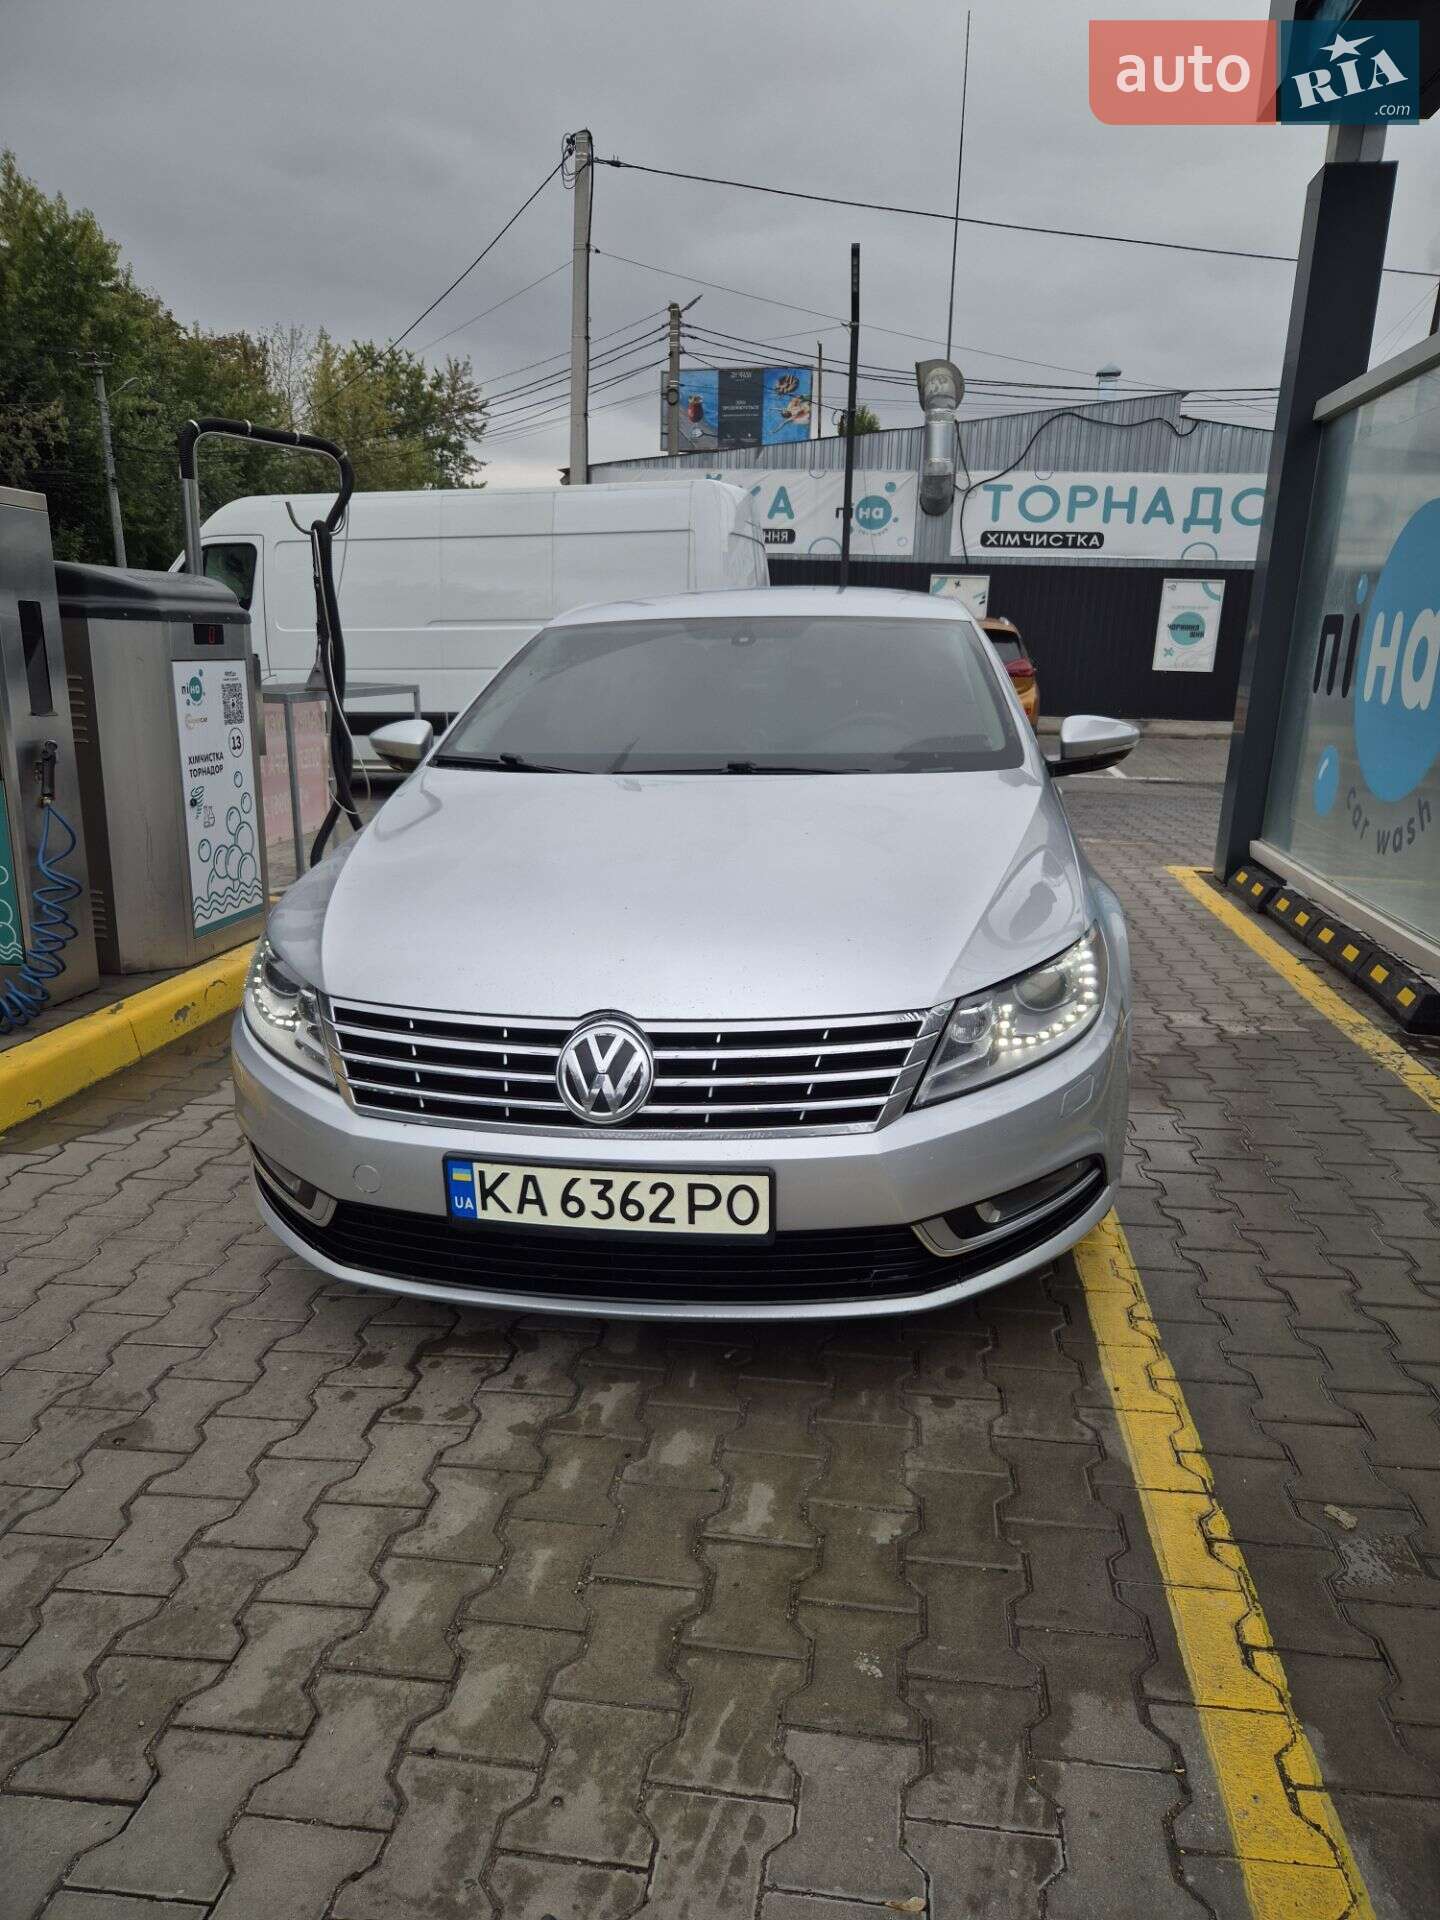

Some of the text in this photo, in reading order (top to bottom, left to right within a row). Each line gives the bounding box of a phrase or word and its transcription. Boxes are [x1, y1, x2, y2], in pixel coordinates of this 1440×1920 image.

[985, 533, 1101, 548] ХІМЧИСТКА
[231, 736, 242, 751] 13
[187, 750, 225, 767] ХІМЧИСТКА
[188, 763, 225, 778] ТОРНАДОР
[1346, 783, 1433, 857] car wash
[454, 1196, 475, 1210] UA
